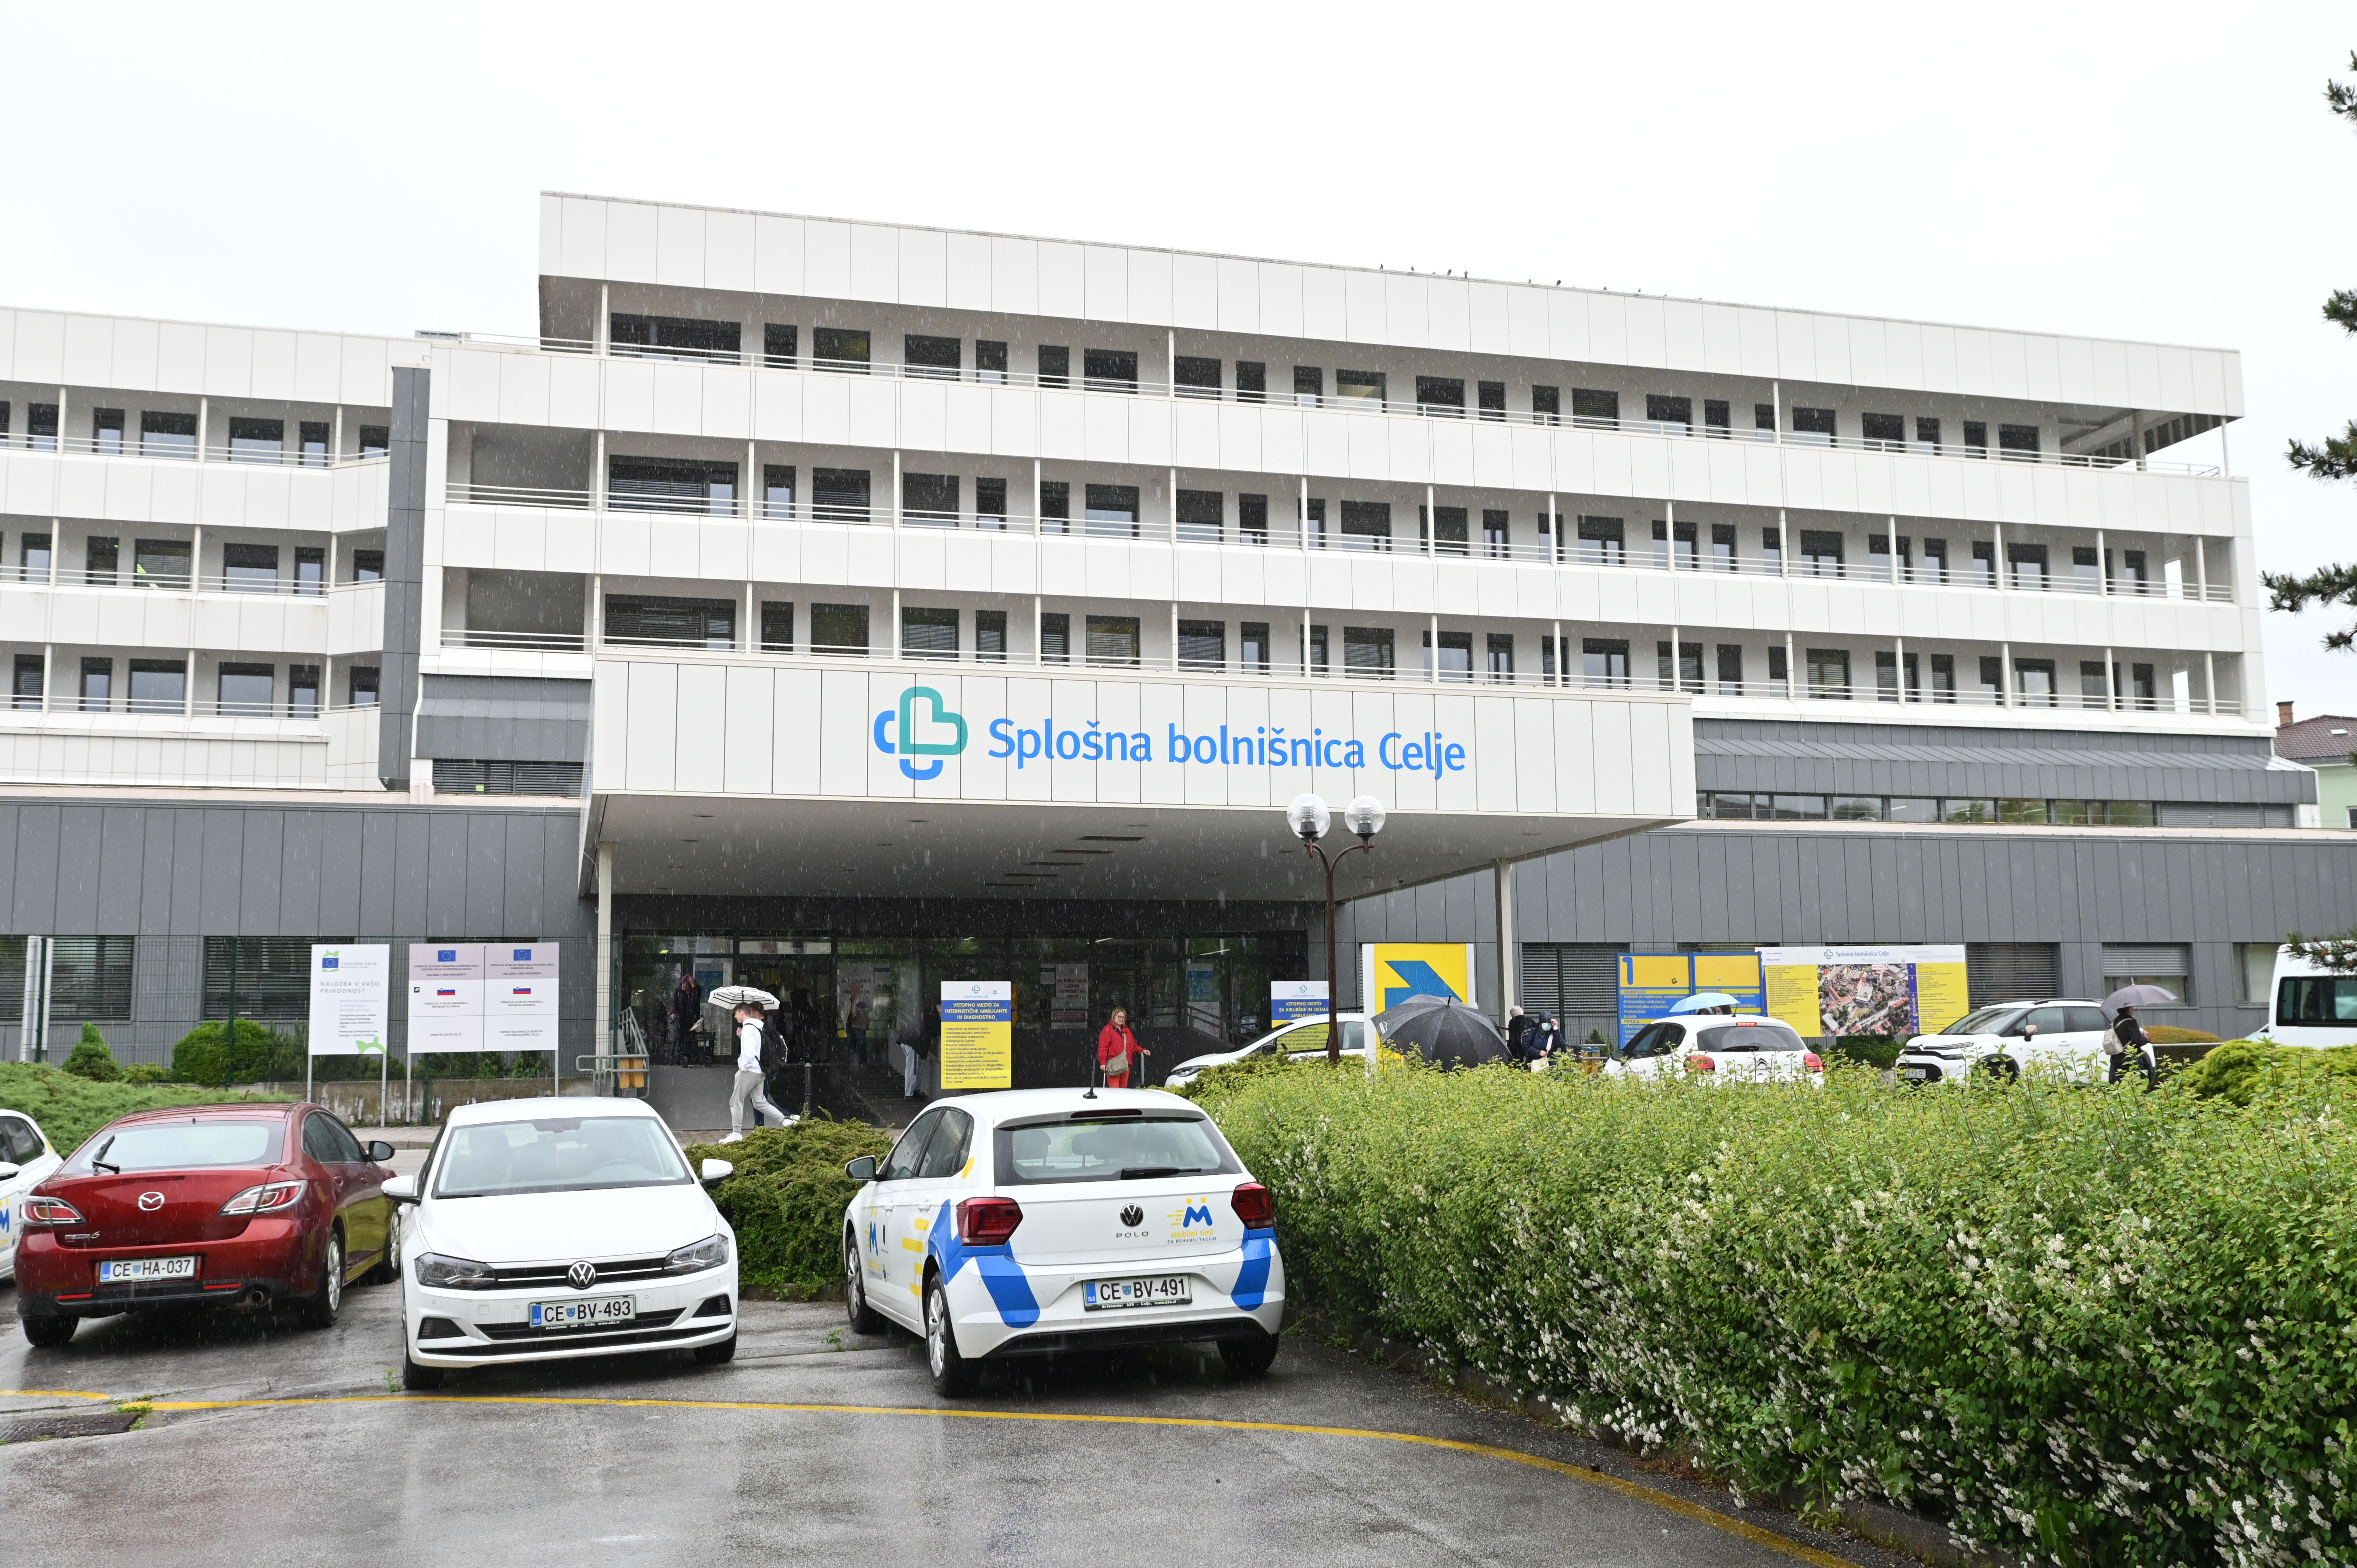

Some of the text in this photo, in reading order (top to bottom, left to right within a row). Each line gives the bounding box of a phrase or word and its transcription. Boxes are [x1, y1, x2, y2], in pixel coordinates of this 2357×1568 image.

[988, 718, 1466, 780] Splošna bolnišnica Celje
[1622, 957, 1633, 985] 1
[1171, 1230, 1198, 1238] Mobilni
[113, 1259, 191, 1277] CE HA-037
[1100, 1283, 1121, 1300] CE
[1133, 1278, 1185, 1298] BV-491
[544, 1306, 564, 1322] CE
[578, 1300, 630, 1319] BV-493
